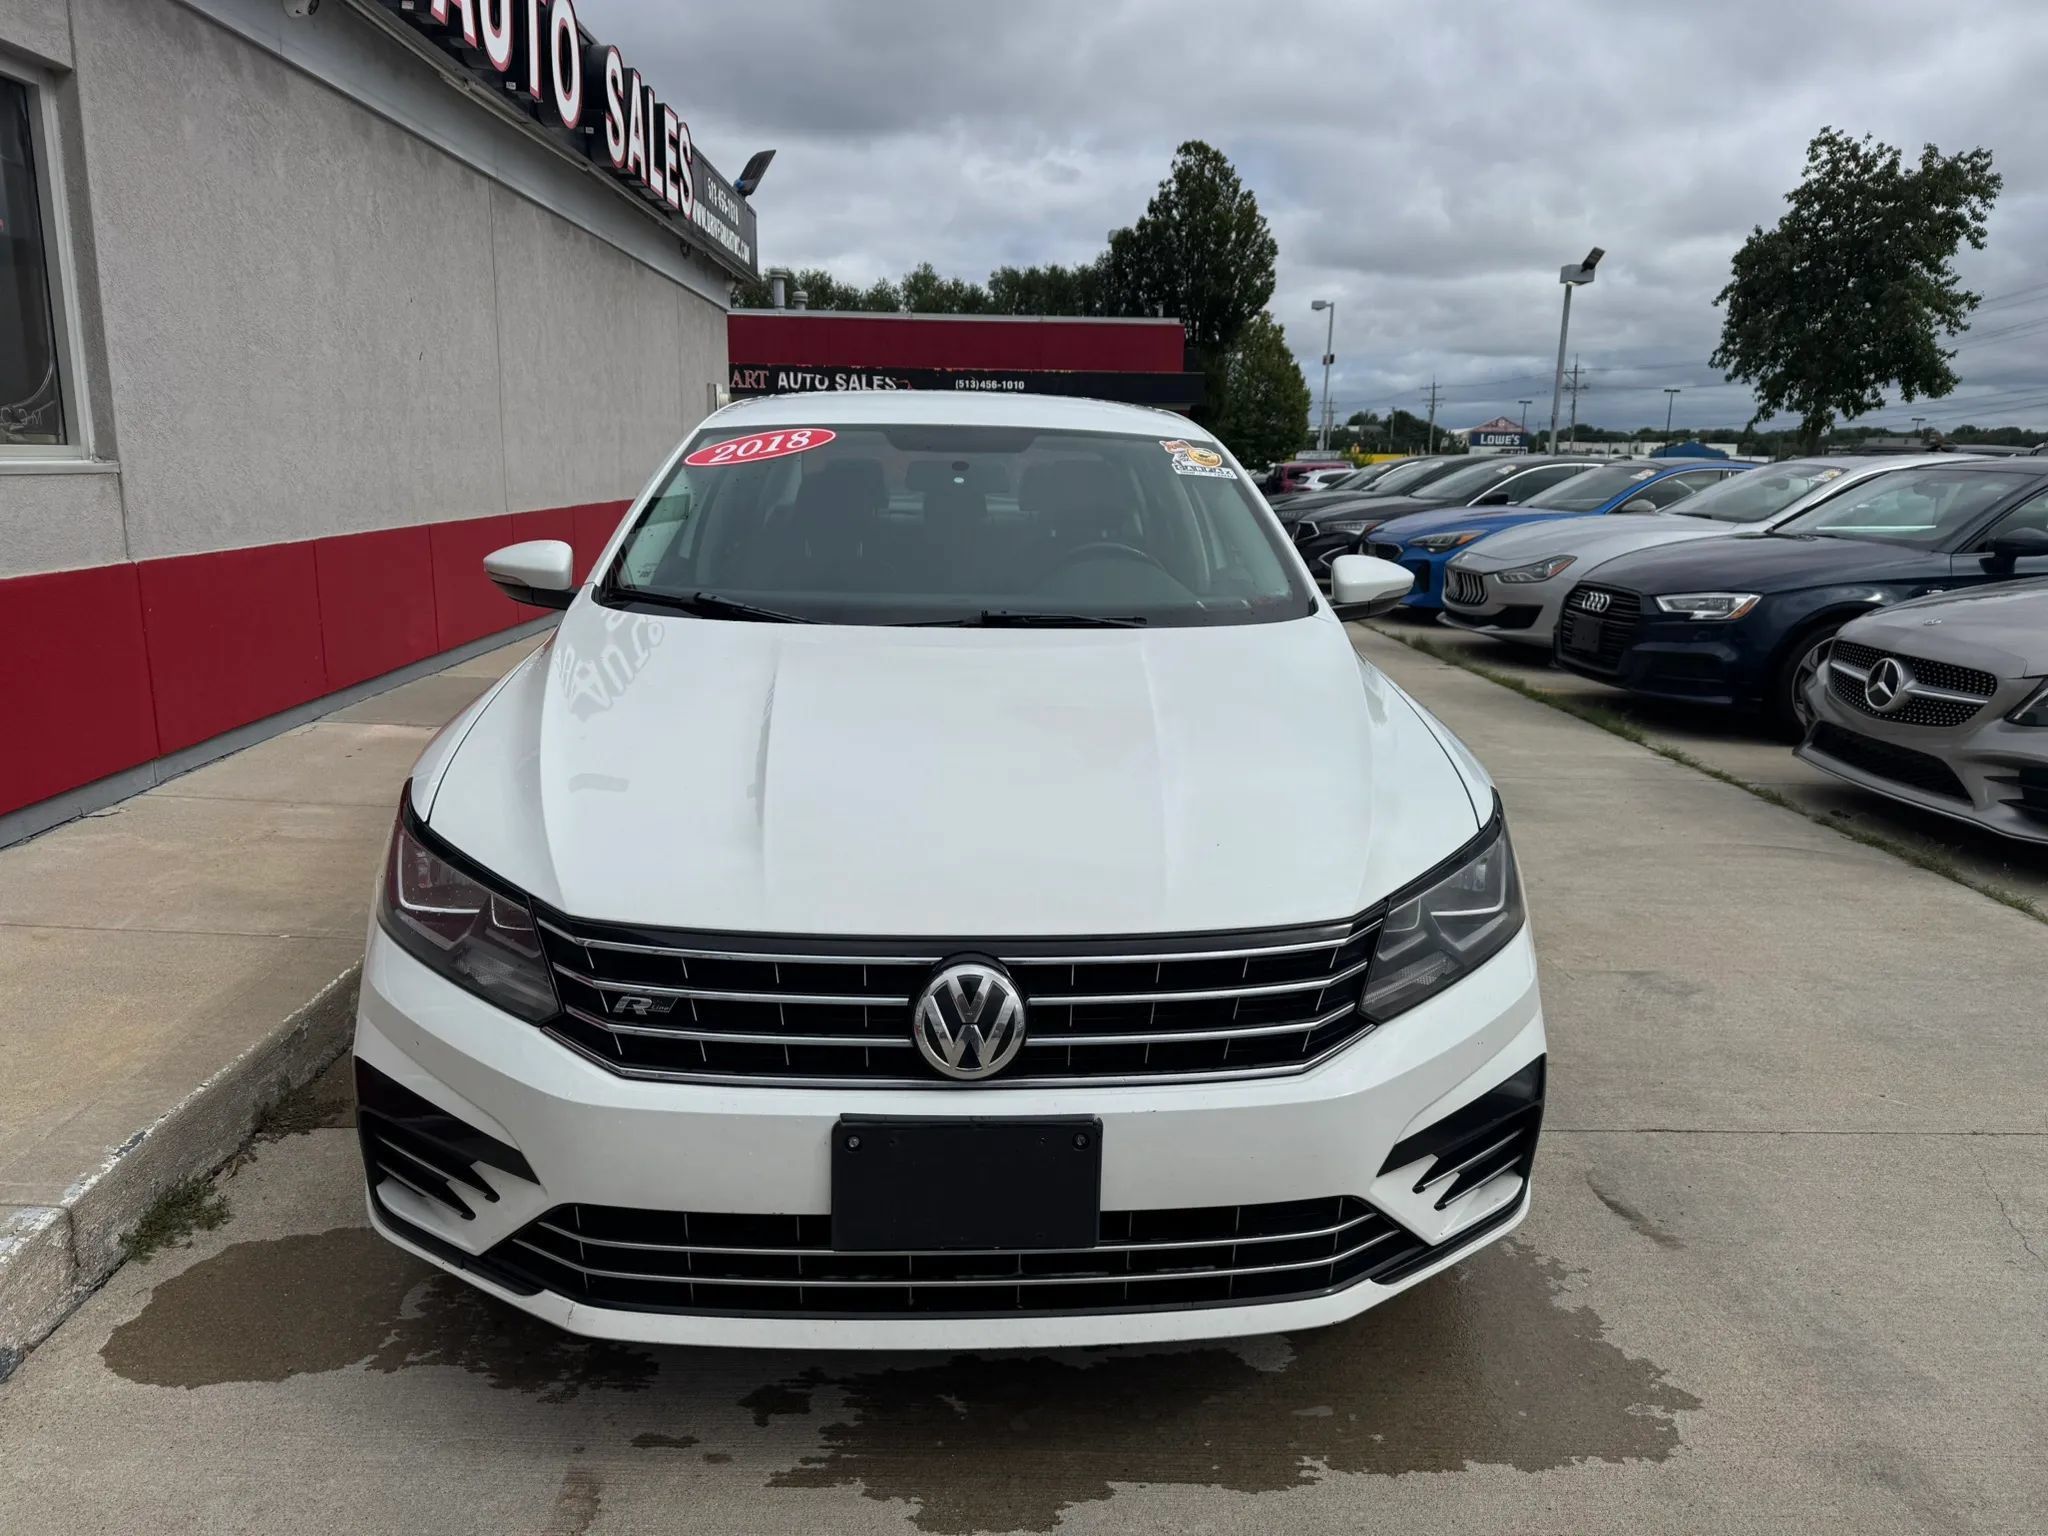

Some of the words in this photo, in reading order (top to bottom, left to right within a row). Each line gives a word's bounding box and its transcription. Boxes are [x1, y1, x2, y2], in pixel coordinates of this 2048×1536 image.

[605, 44, 695, 220] SALES
[777, 371, 829, 390] AUTO
[835, 373, 897, 391] SALES
[955, 379, 1025, 390] (513)456-1010
[708, 430, 812, 463] 2018
[1479, 433, 1521, 446] LOWE'S
